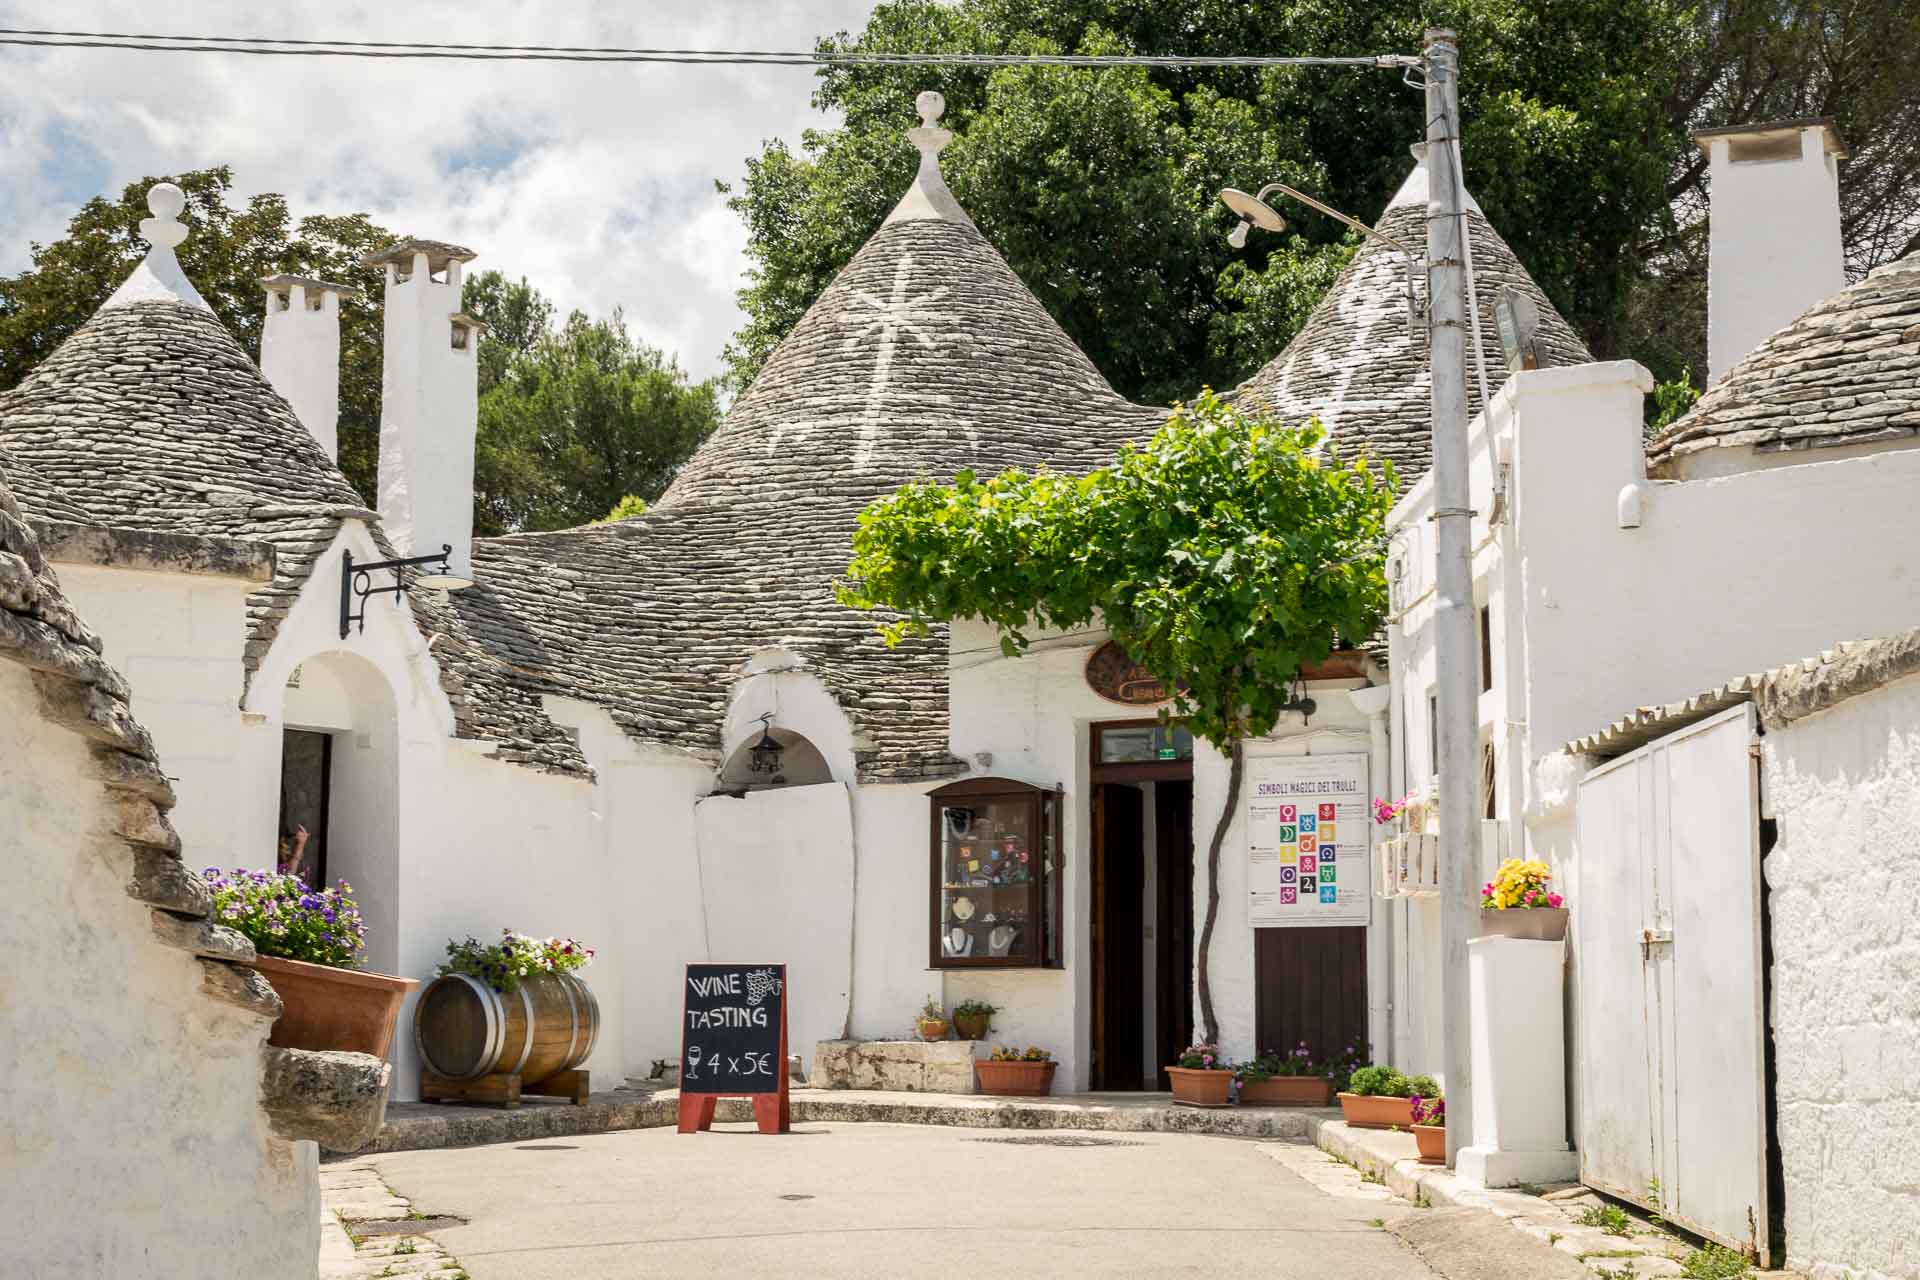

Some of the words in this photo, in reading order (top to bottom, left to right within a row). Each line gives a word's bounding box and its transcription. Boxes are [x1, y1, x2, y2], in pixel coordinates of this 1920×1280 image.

[1258, 783, 1288, 795] SIMBOLI
[1290, 781, 1318, 793] MAGICI
[1318, 780, 1331, 792] DEI
[1332, 779, 1356, 792] TRULLI
[688, 973, 741, 998] WINE
[687, 1007, 768, 1029] TASTING
[707, 1052, 721, 1075] 4
